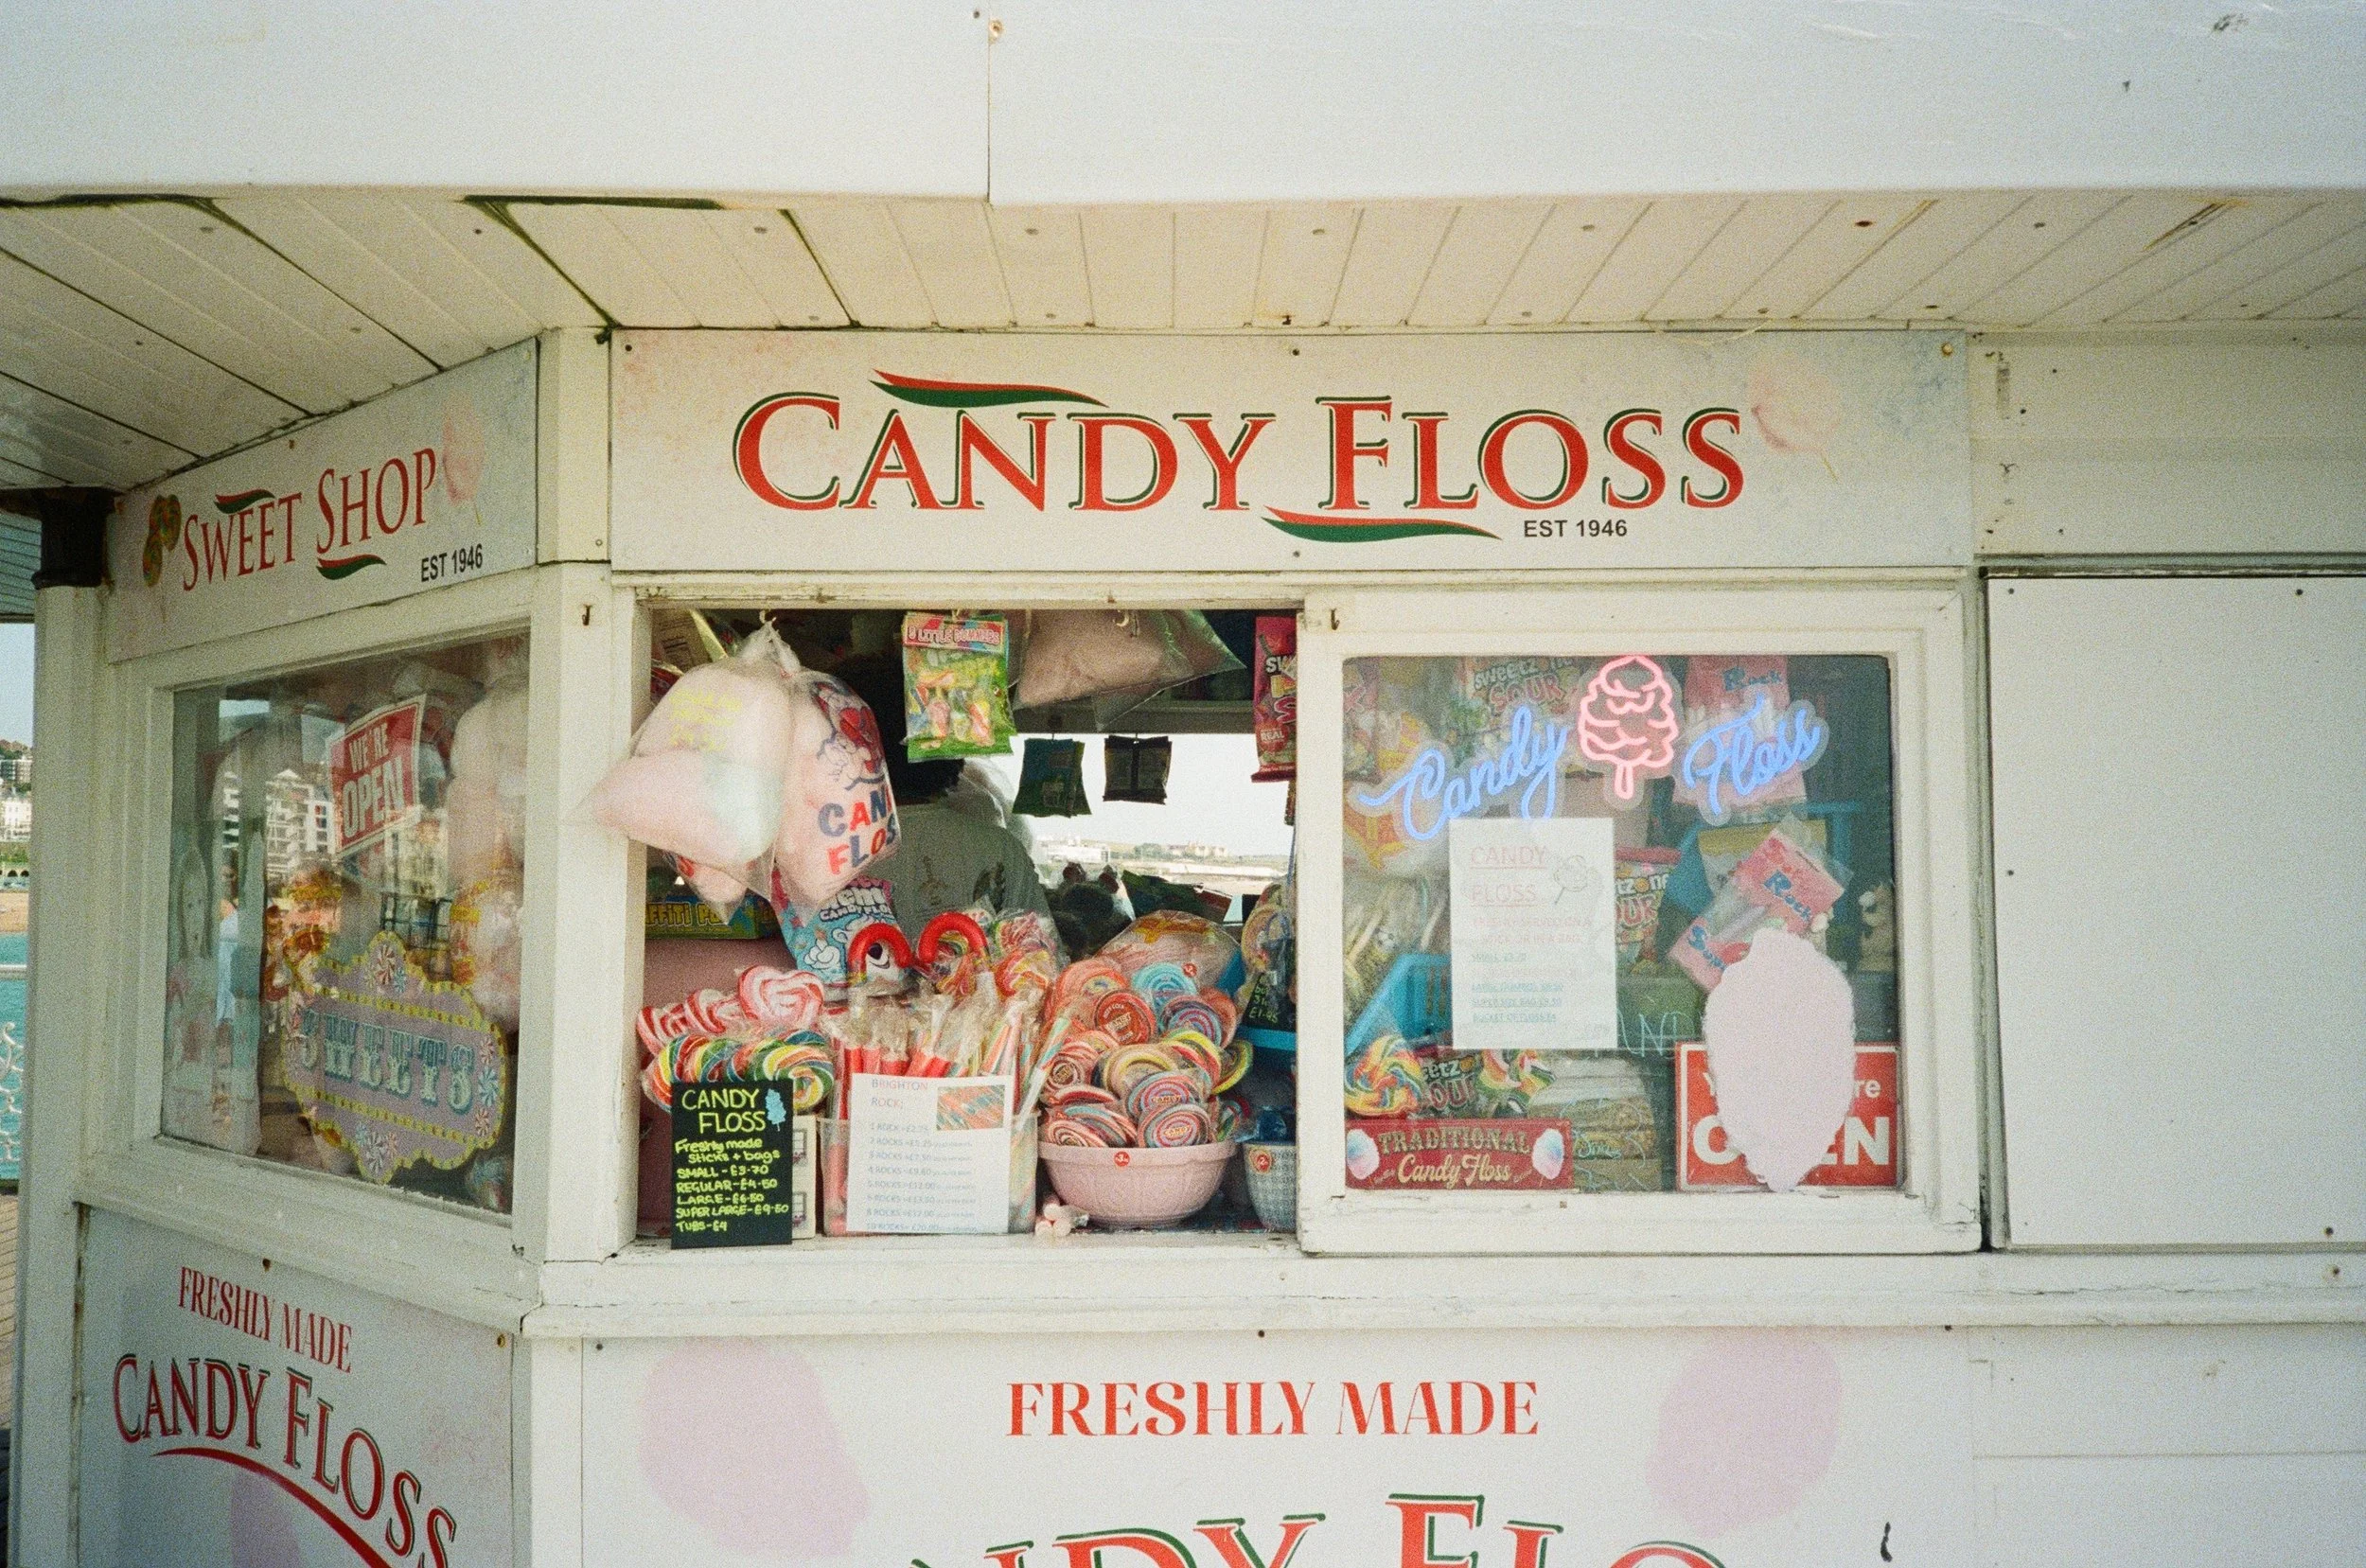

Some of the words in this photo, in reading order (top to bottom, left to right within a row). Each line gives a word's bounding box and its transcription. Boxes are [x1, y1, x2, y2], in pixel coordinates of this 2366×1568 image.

[733, 391, 1277, 512] CANDY
[1315, 395, 1744, 511] FLOSS
[183, 491, 303, 592] SWEET
[316, 447, 437, 555] SHOP
[1524, 520, 1566, 538] EST
[1576, 519, 1628, 538] 1946
[421, 553, 448, 583] EST
[450, 543, 484, 573] 1946
[349, 722, 389, 773] WE'RE
[1684, 692, 1824, 818] Floss
[1356, 704, 1569, 840] Candy
[343, 757, 405, 838] OPEN
[818, 784, 893, 837] CAN
[1470, 845, 1546, 866] CANDY
[1471, 883, 1537, 903] FLOSS
[301, 1008, 474, 1116] SWEETS
[681, 1088, 760, 1110] CANDY
[871, 1078, 928, 1091] BRIGHTON
[698, 1111, 767, 1134] FLOSS
[1378, 1126, 1532, 1154] TRADITIONAL
[675, 1138, 724, 1154] Freshly
[726, 1137, 763, 1149] made
[743, 1150, 781, 1164] bags
[676, 1167, 718, 1178] SMALL
[1397, 1154, 1462, 1189] Candy
[1461, 1154, 1511, 1186] Floss
[677, 1193, 724, 1205] LARGE
[676, 1220, 706, 1232] TUBS
[177, 1266, 274, 1342] FRESHLY
[281, 1302, 353, 1374] MADE
[1005, 1381, 1316, 1437] FRESHLY
[1335, 1381, 1540, 1437] MADE
[113, 1353, 271, 1450] CANDY
[283, 1366, 457, 1568] FLOSS
